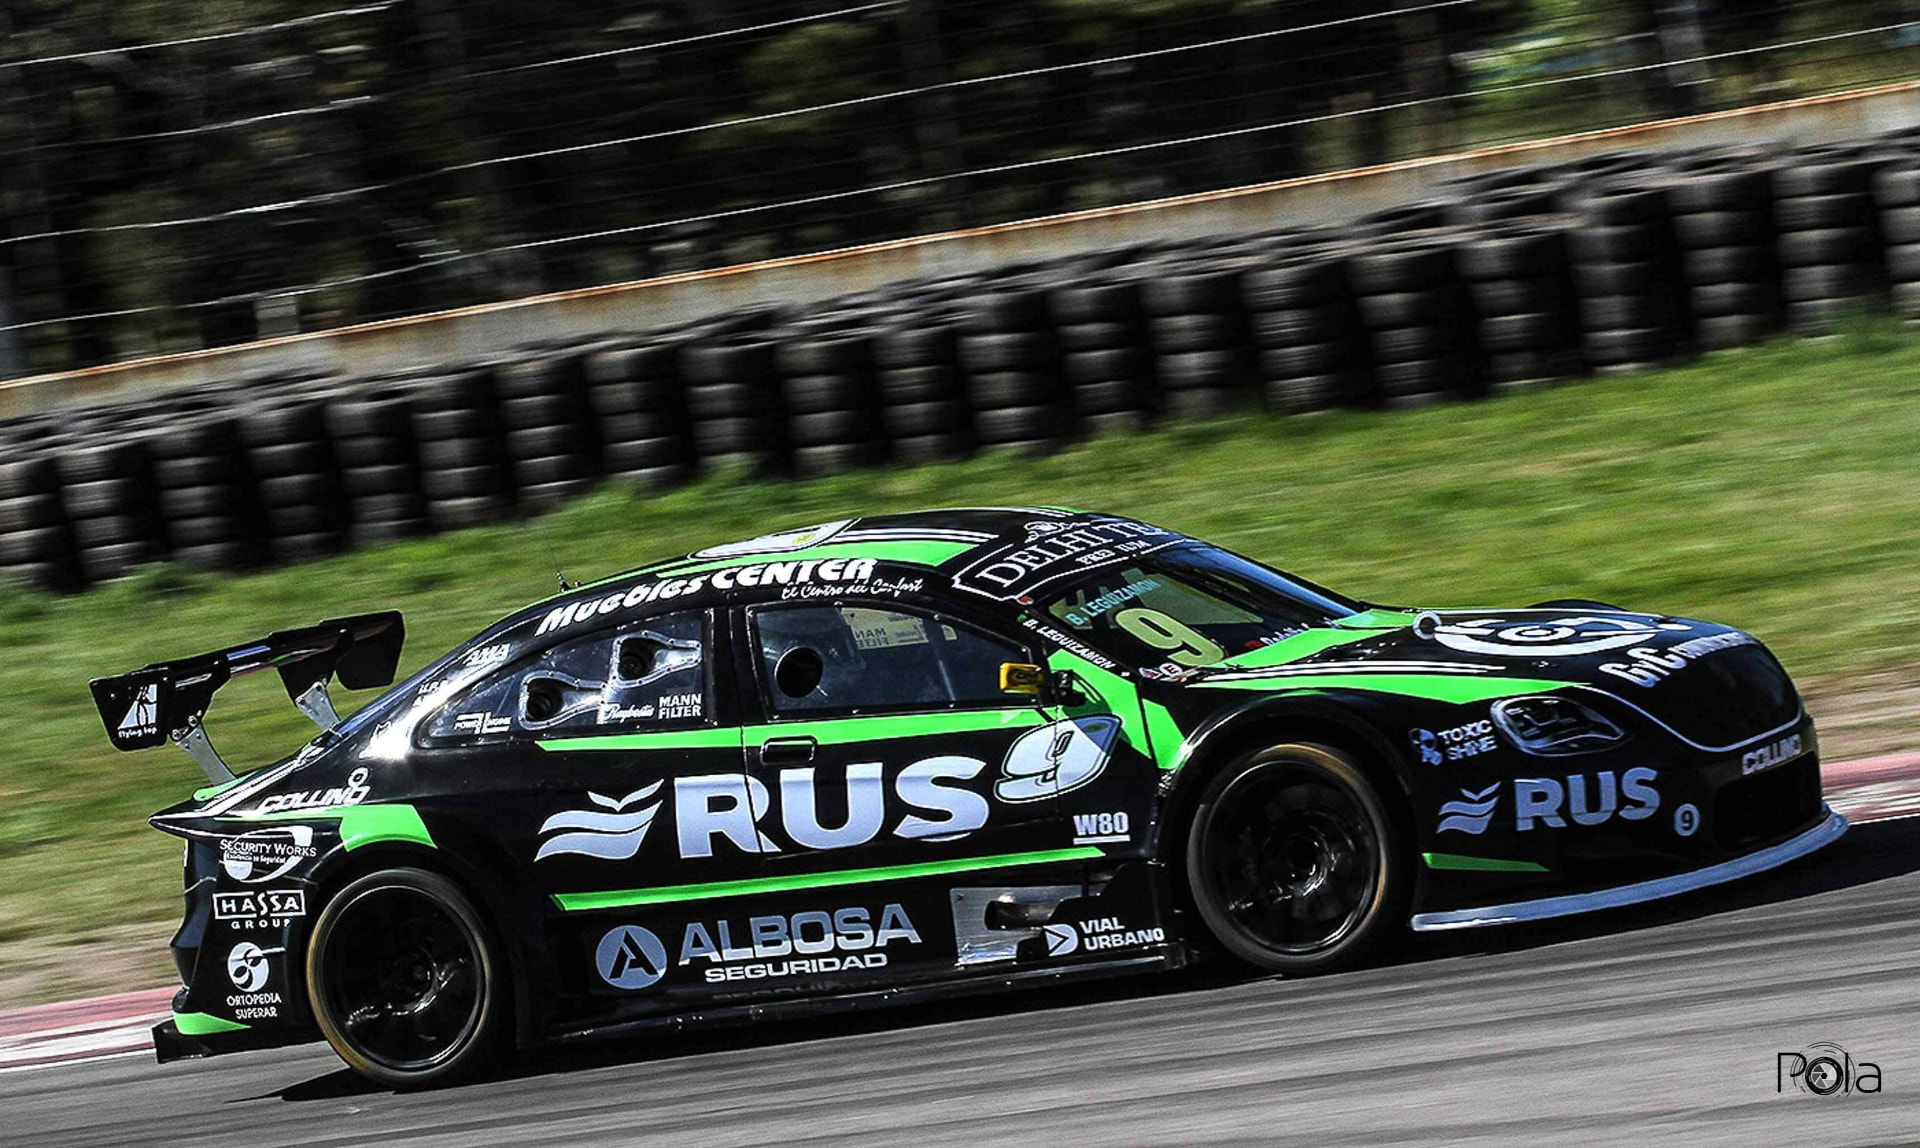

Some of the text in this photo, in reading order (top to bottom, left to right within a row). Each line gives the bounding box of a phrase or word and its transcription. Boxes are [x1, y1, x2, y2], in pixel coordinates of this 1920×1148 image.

[975, 529, 1114, 588] DELHI
[534, 557, 878, 637] Muebles CENTER
[1115, 608, 1226, 667] 9
[658, 704, 702, 719] FILTER
[659, 693, 702, 708] MANN
[1437, 719, 1493, 744] TOXIC
[994, 713, 1122, 804] 9
[674, 754, 991, 860] RUS
[1514, 767, 1661, 832] RUS
[1073, 811, 1130, 836] W80
[220, 839, 318, 858] SECURITY WORKS
[220, 892, 300, 916] HASSA
[231, 919, 291, 929] GROUP
[678, 903, 923, 966] ALBOSA
[1079, 917, 1126, 934] VIAL
[1084, 927, 1166, 950] URBANO
[705, 953, 889, 983] SEGURIDAD
[226, 992, 282, 1007] ORTOPEDIA
[235, 1006, 278, 1020] SUPERAR
